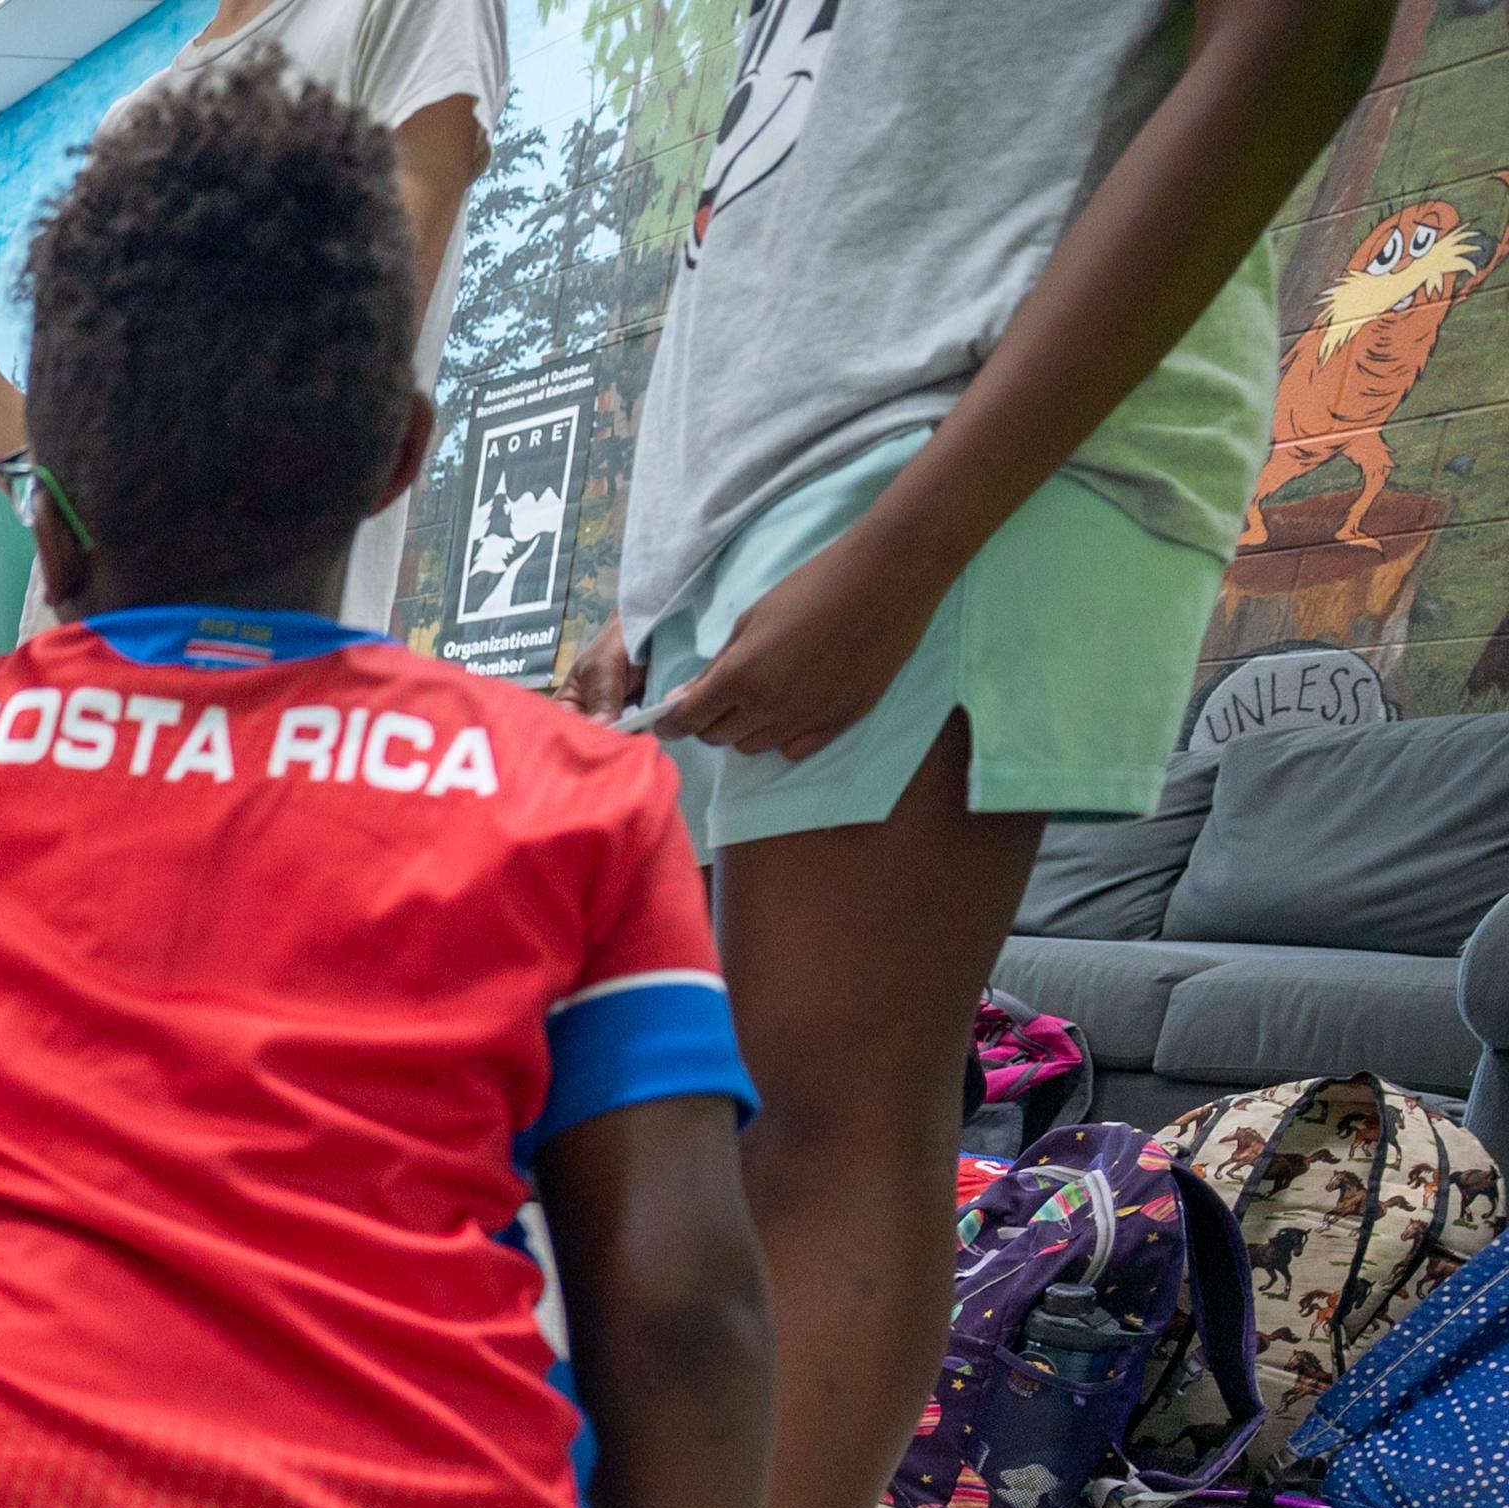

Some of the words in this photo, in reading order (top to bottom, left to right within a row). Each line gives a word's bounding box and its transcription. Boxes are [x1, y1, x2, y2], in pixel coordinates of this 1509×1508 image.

[475, 395, 526, 418] Recreation
[525, 388, 545, 404] and
[545, 376, 595, 399] Education
[484, 378, 538, 402] Association
[539, 372, 550, 387] of
[550, 363, 591, 383] Outdoor
[443, 626, 555, 660] Organizational
[465, 657, 527, 677] Member
[1206, 663, 1373, 745] UNLESS
[266, 704, 500, 797] RICA
